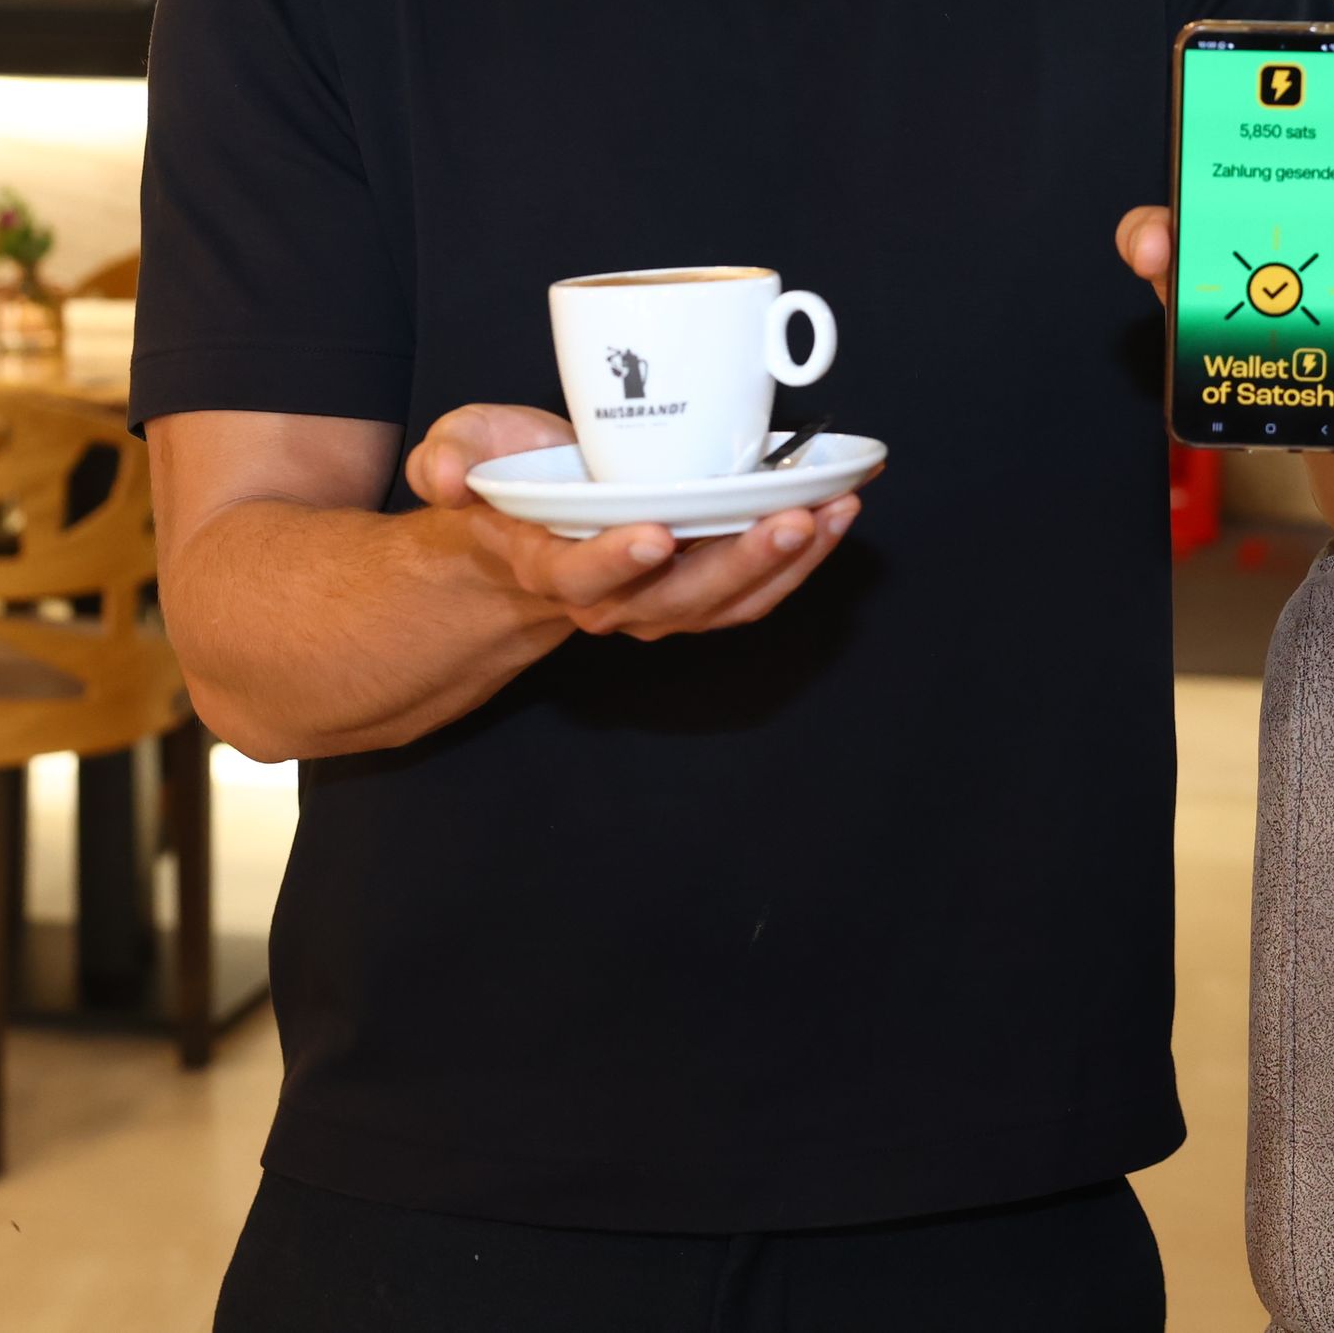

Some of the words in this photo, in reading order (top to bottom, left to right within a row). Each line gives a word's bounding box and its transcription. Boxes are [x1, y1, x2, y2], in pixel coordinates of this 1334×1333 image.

[1239, 123, 1283, 141] 5,850
[1285, 126, 1317, 140] sats
[1212, 162, 1273, 182] Zahlung
[1203, 354, 1290, 379] Wallet
[1202, 380, 1233, 405] of
